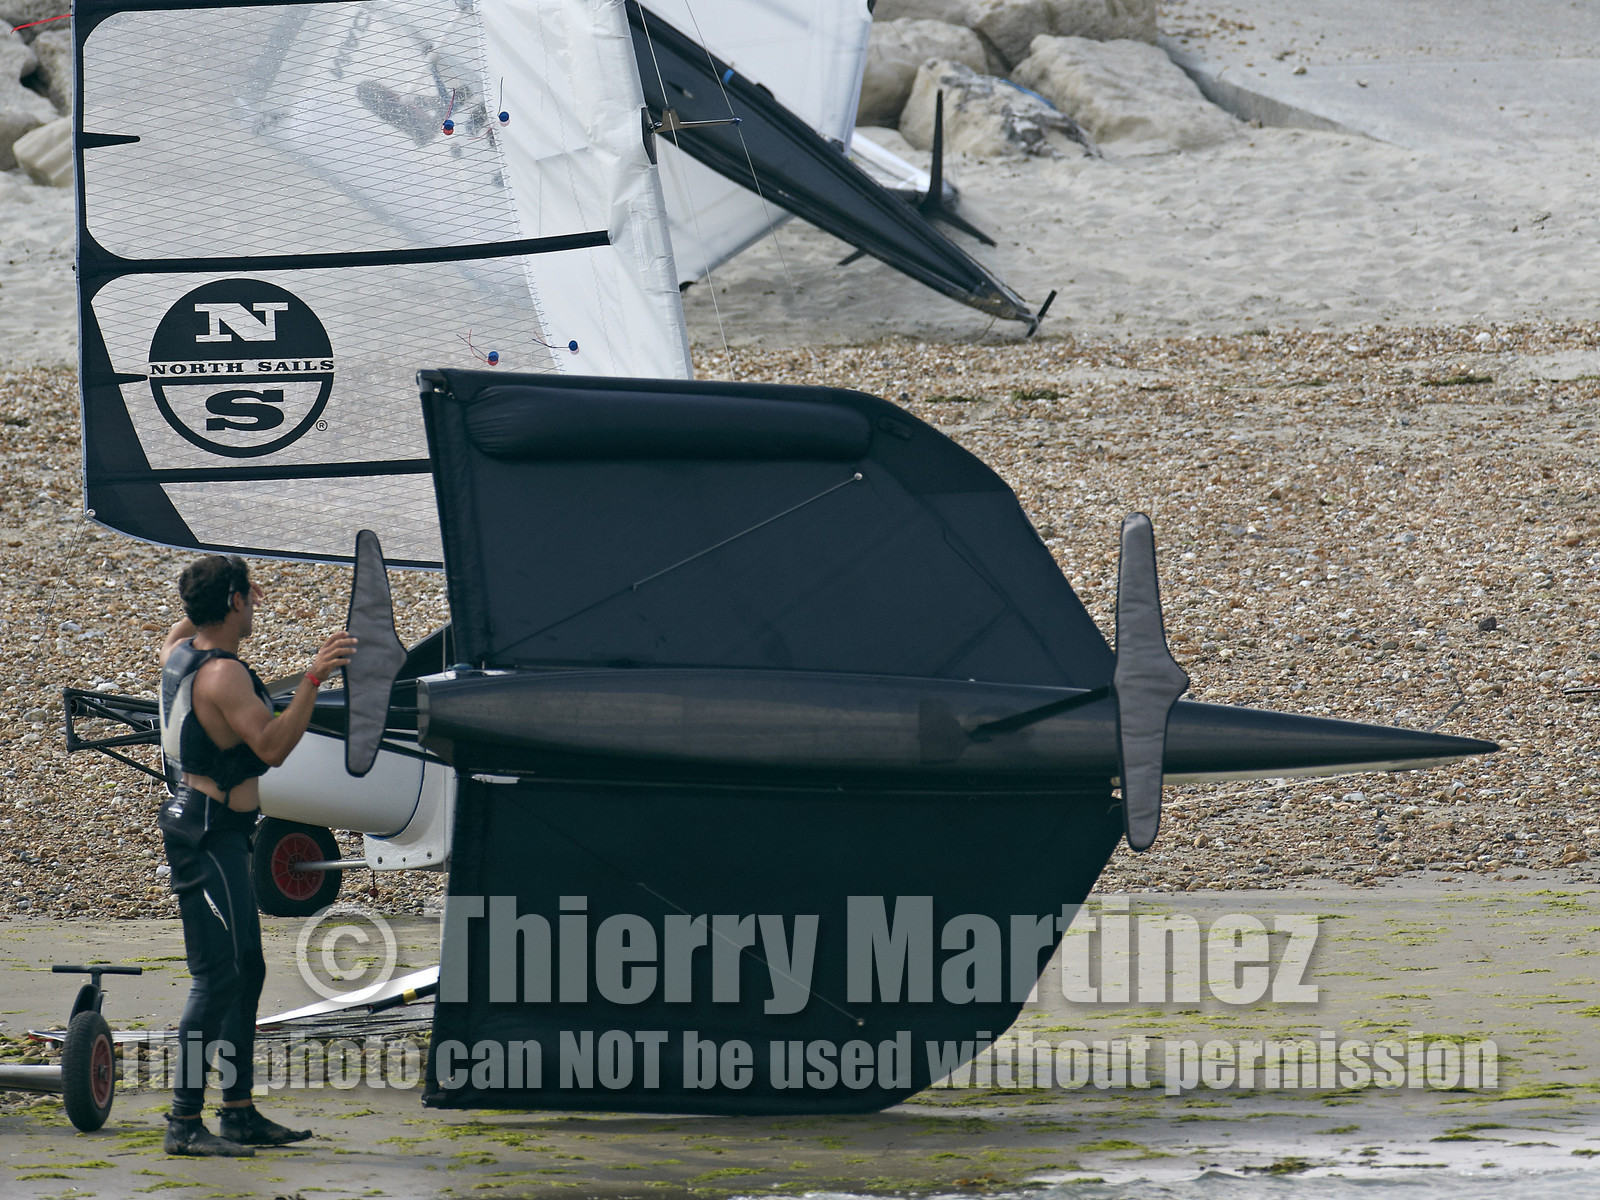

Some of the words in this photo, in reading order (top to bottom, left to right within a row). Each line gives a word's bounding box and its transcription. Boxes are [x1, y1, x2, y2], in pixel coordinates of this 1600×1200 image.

[194, 302, 289, 343] N
[150, 362, 244, 375] NORTH
[258, 359, 335, 372] SAILS
[205, 389, 285, 432] S
